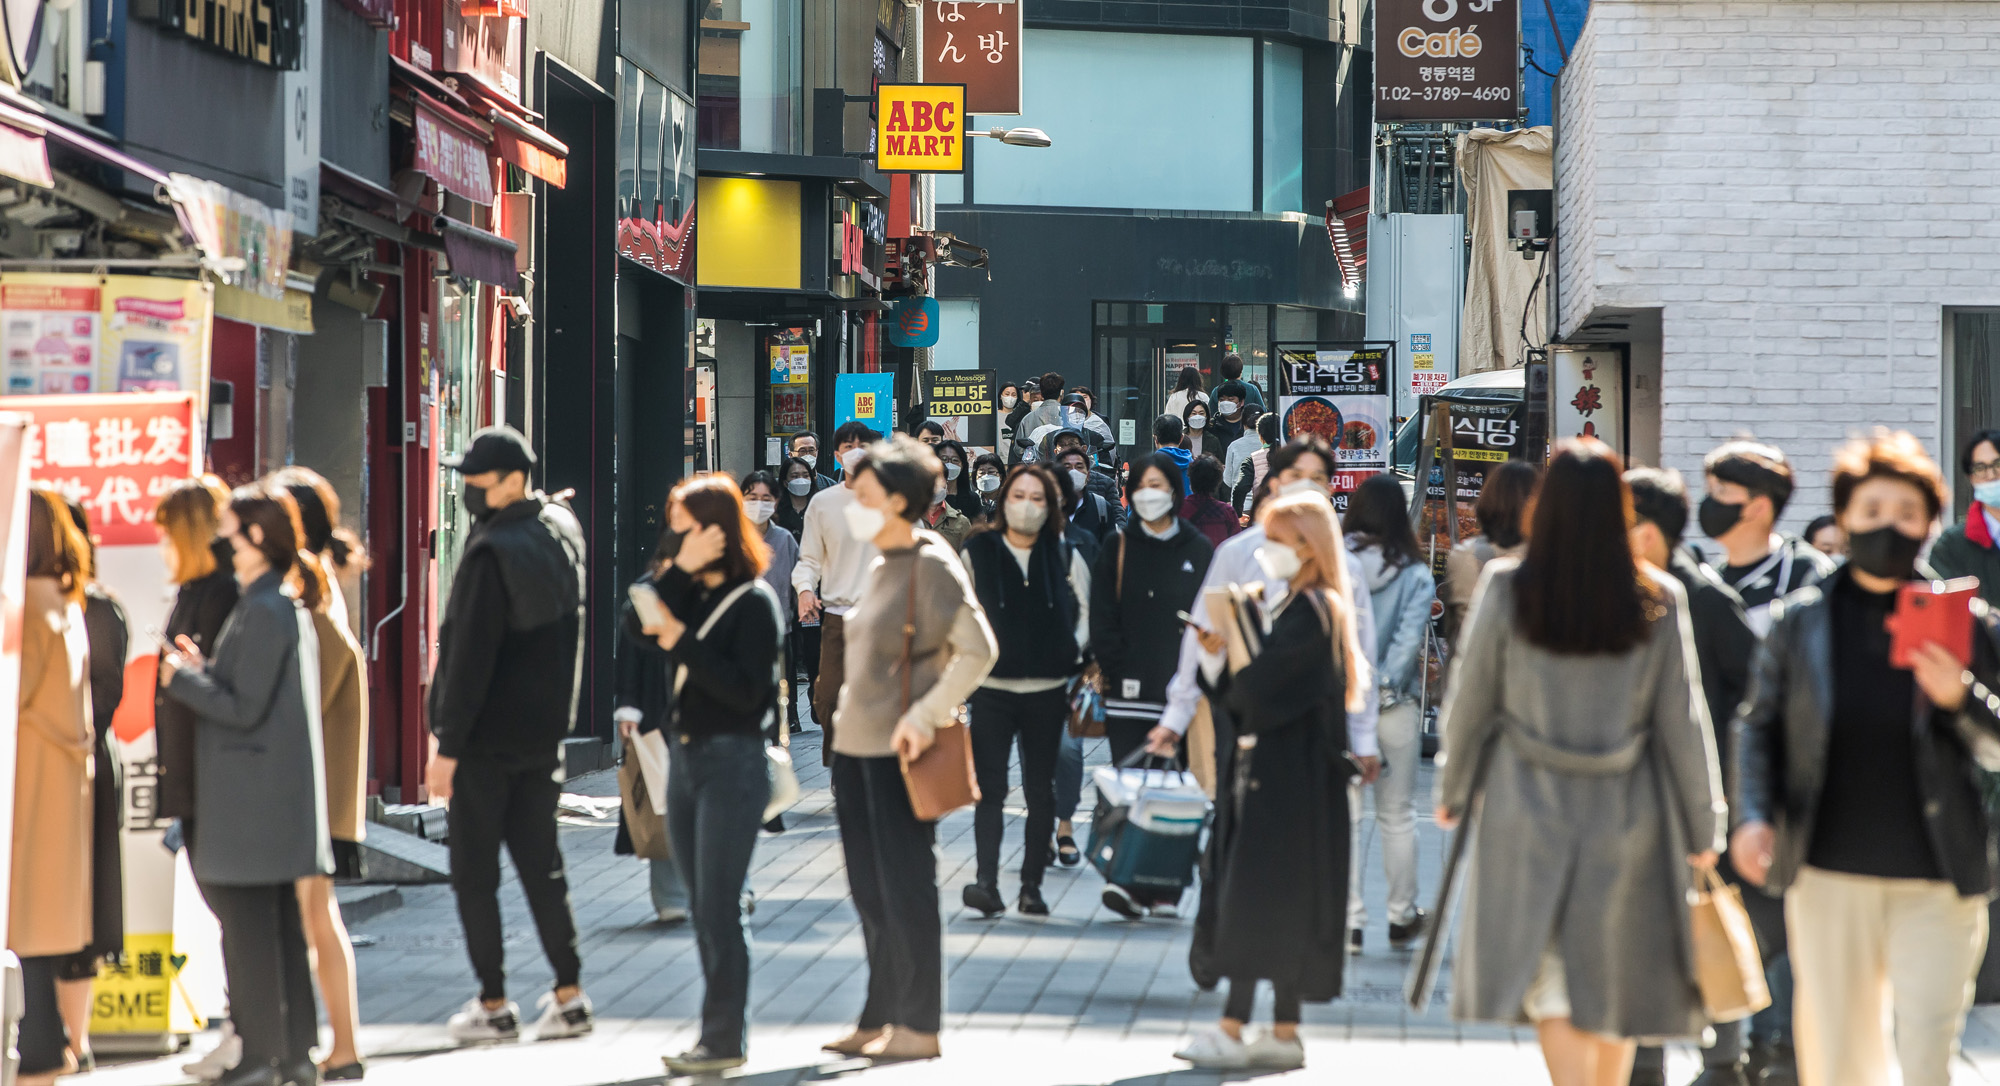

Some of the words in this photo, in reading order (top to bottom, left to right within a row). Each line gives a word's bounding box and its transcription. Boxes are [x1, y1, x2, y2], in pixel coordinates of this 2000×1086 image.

[1397, 25, 1482, 58] Café
[1419, 67, 1475, 82] 명동역점
[1380, 86, 1511, 101] T.02-3789-4690
[886, 101, 955, 132] ABC
[886, 135, 955, 157] MART
[1291, 362, 1366, 384] 더식당
[969, 385, 987, 400] 5F
[857, 397, 873, 406] ABC
[1339, 450, 1380, 460] 열무냉국수
